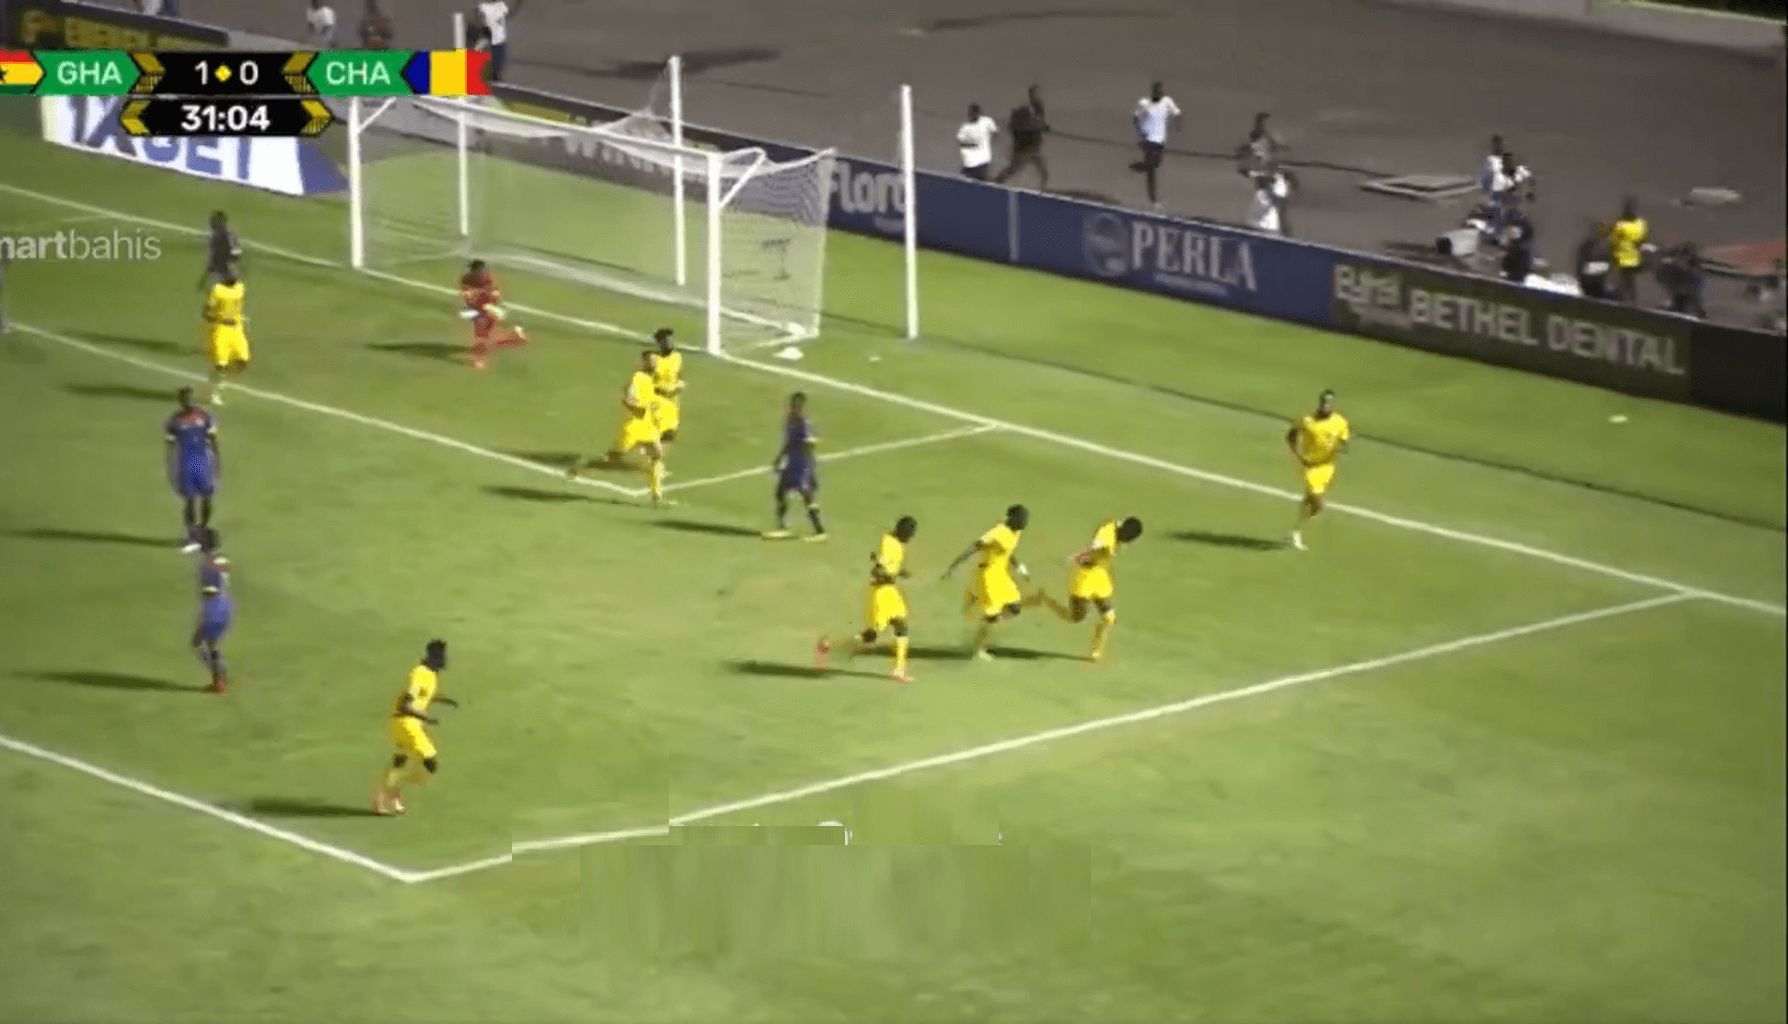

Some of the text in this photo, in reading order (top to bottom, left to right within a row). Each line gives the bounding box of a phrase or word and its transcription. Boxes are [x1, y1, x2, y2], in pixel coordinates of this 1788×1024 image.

[1132, 220, 1257, 292] PERLA
[1409, 288, 1539, 345] BETHEL
[1548, 314, 1685, 376] DENTAL
